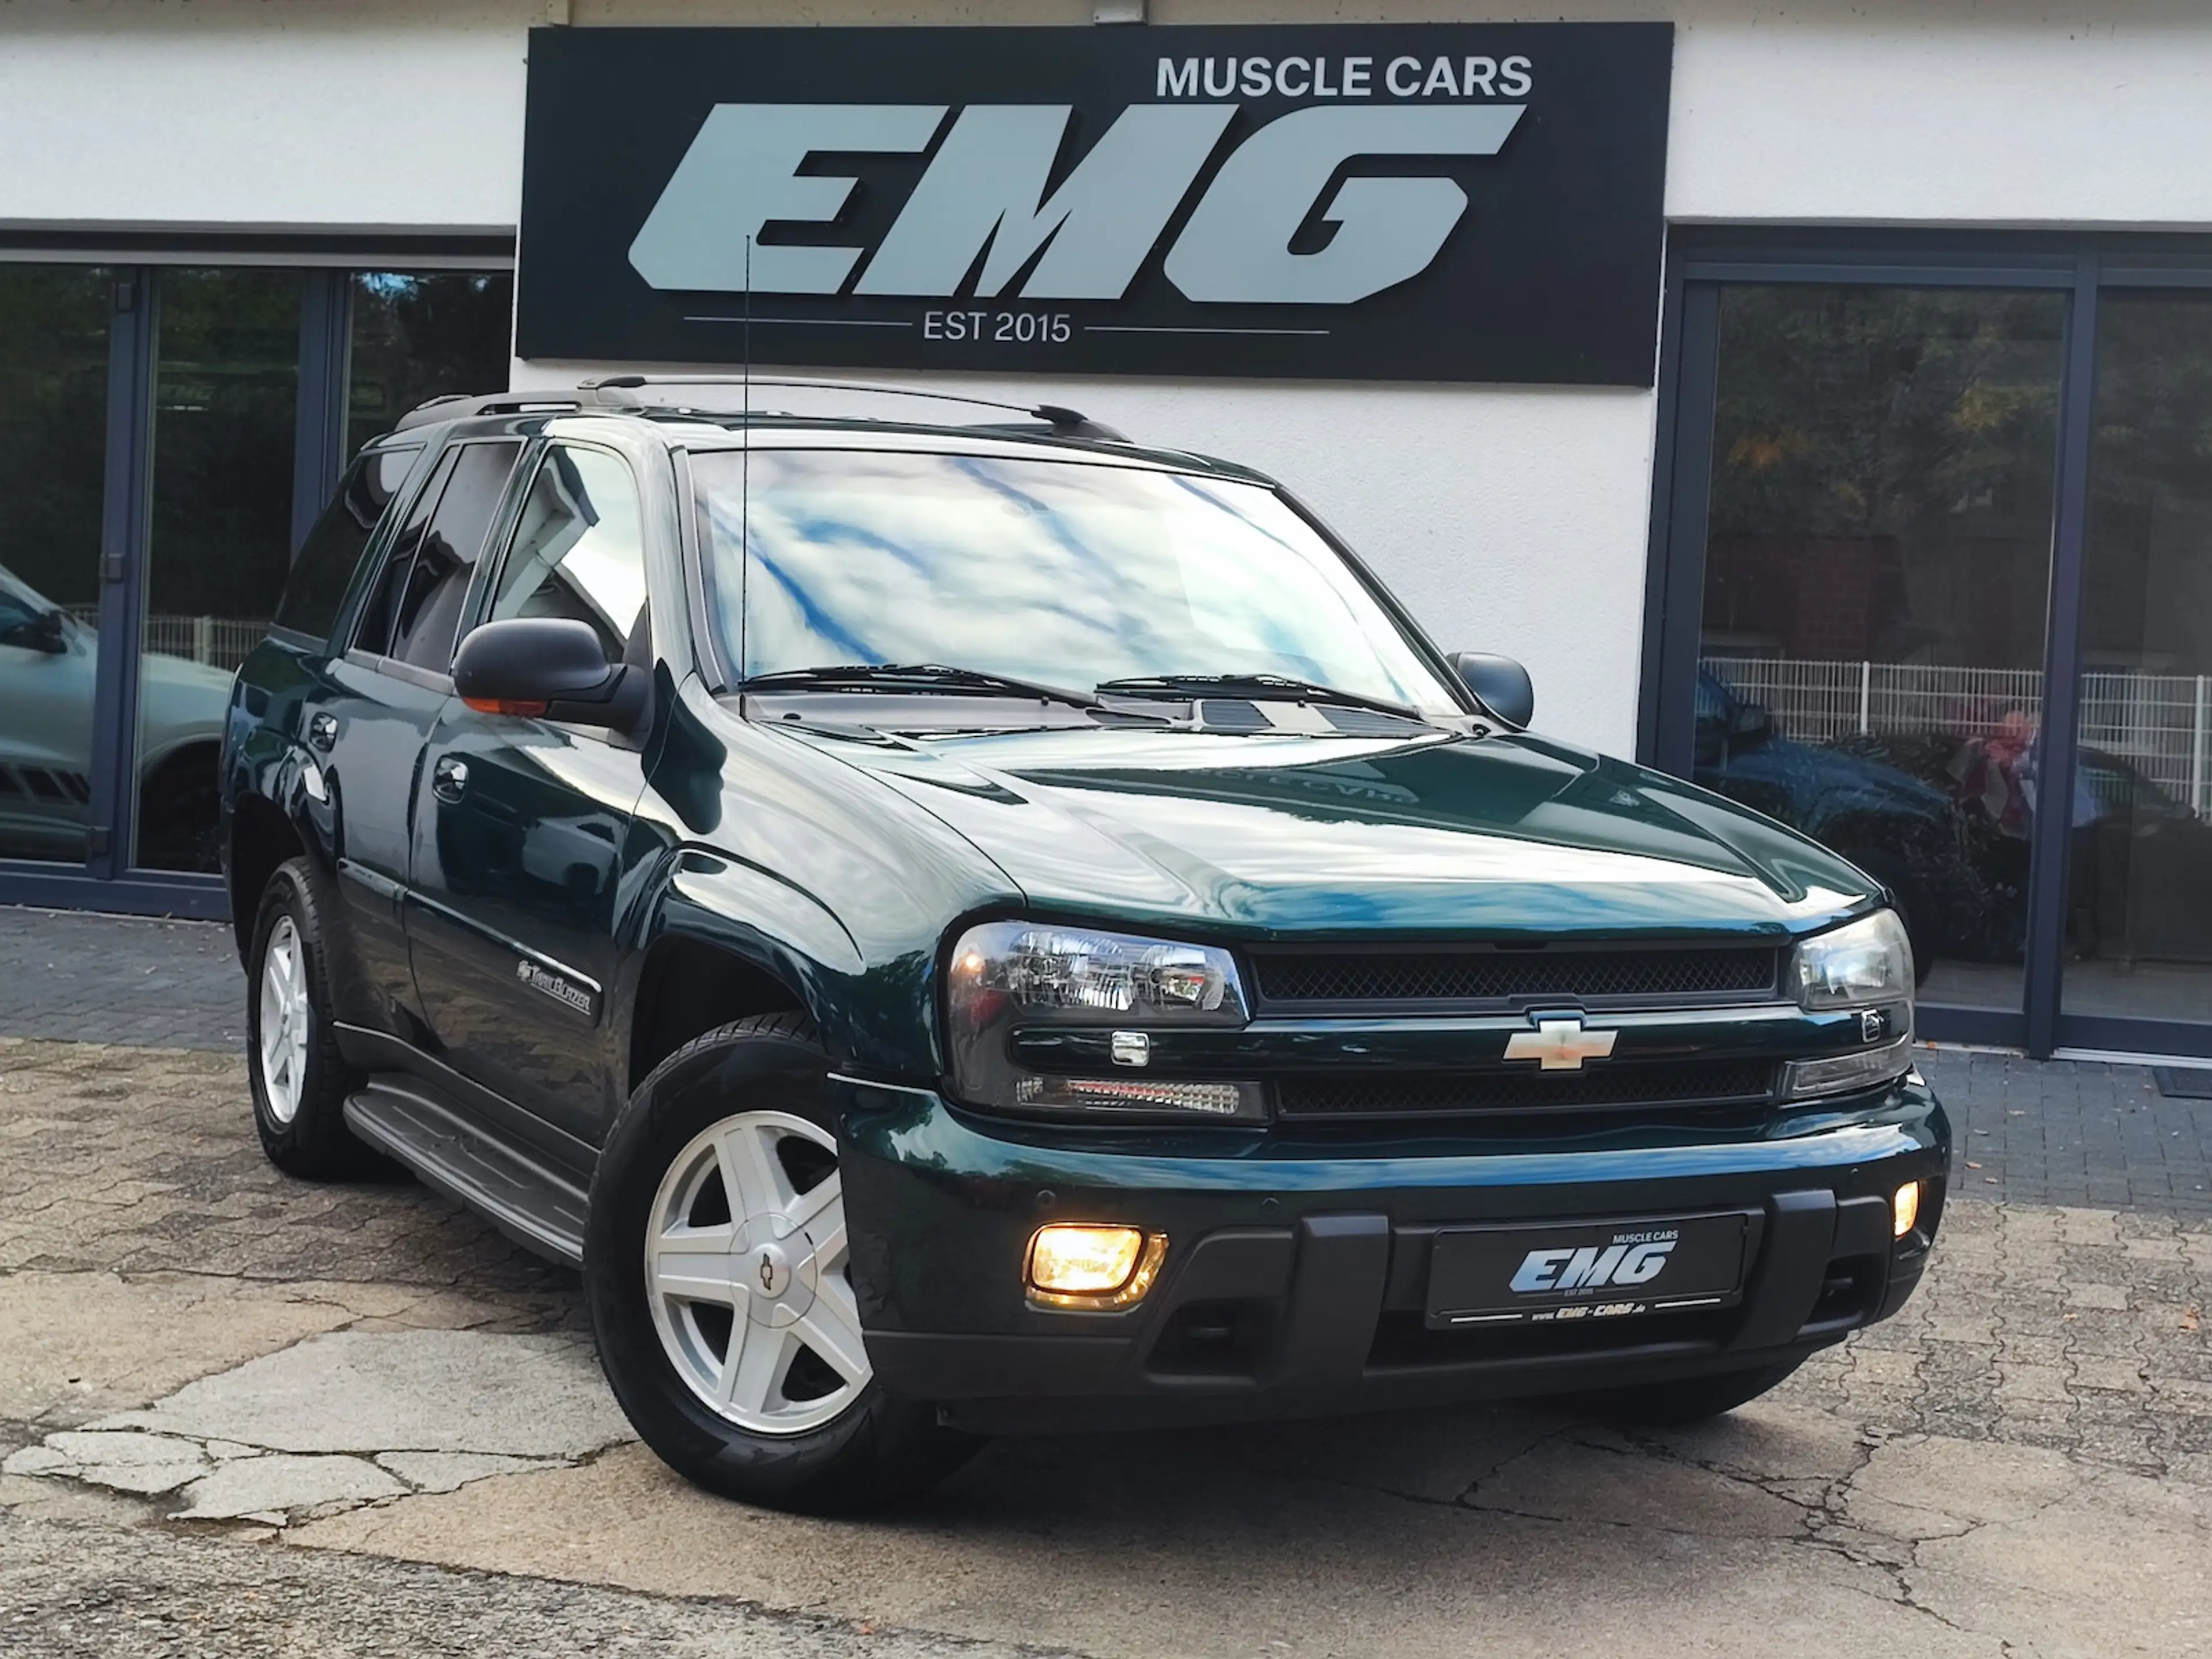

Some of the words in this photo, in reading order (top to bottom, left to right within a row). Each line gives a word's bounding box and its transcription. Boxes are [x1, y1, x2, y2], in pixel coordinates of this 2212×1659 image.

[1156, 56, 1373, 97] MUSCLE
[1385, 56, 1532, 97] CARS
[627, 103, 1528, 304] EMG
[924, 311, 987, 340] EST
[994, 312, 1071, 342] 2015
[1612, 1232, 1652, 1244] MUSCLE
[1653, 1229, 1679, 1241] CARS
[1508, 1241, 1677, 1293] EMG
